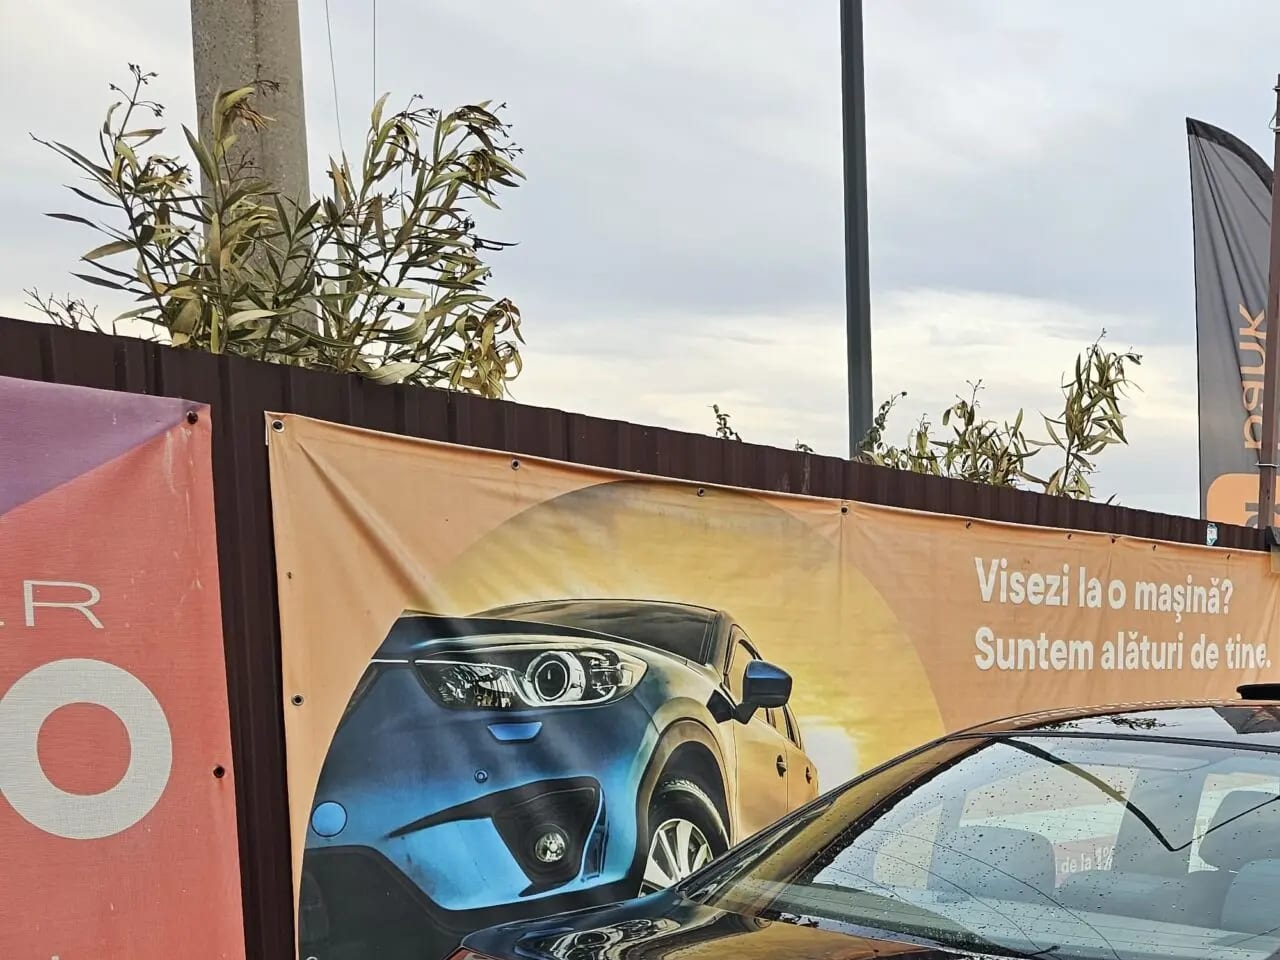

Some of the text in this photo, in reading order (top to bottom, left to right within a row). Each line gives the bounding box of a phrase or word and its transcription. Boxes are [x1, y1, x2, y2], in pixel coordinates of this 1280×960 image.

[974, 557, 1234, 623] Visezi la o mașină?
[974, 626, 1272, 670] Suntem alături de tine.
